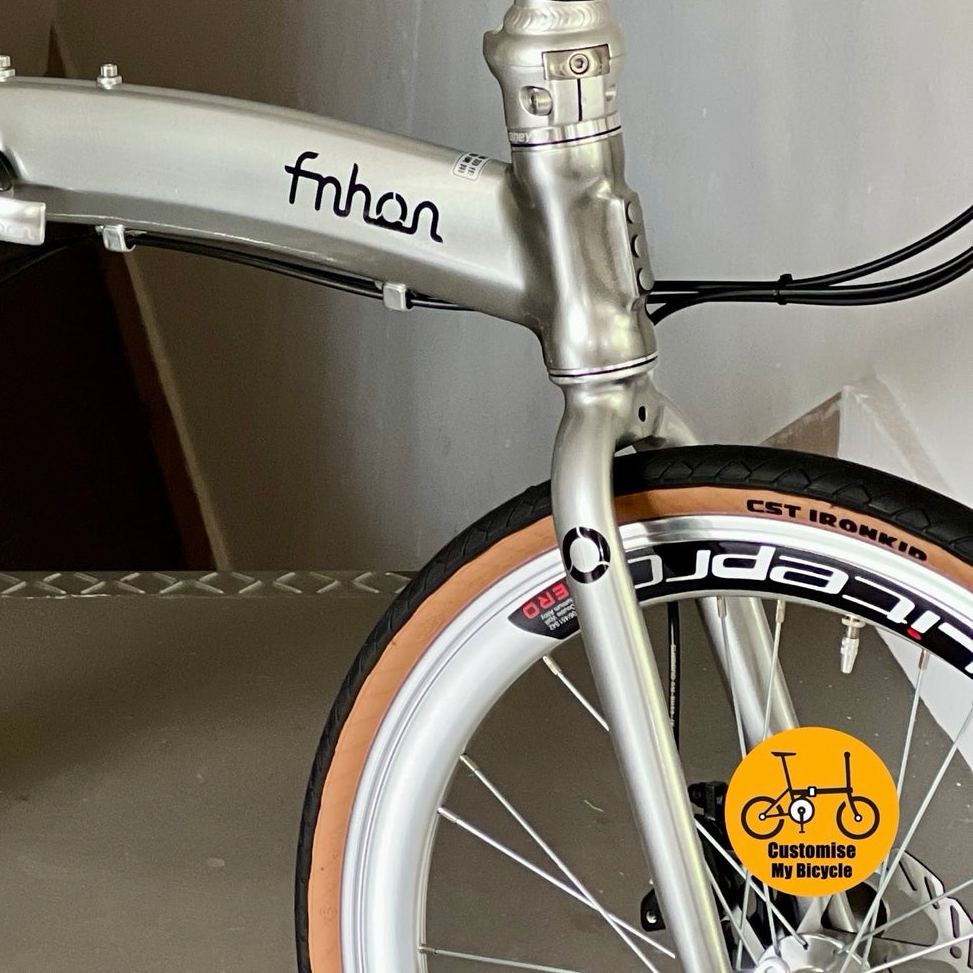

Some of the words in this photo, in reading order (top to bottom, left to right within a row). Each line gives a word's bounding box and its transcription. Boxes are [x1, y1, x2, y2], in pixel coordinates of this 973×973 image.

[284, 151, 444, 244] fnhon
[746, 499, 801, 519] CST
[809, 508, 928, 562] IRONKID
[522, 583, 570, 619] ERO
